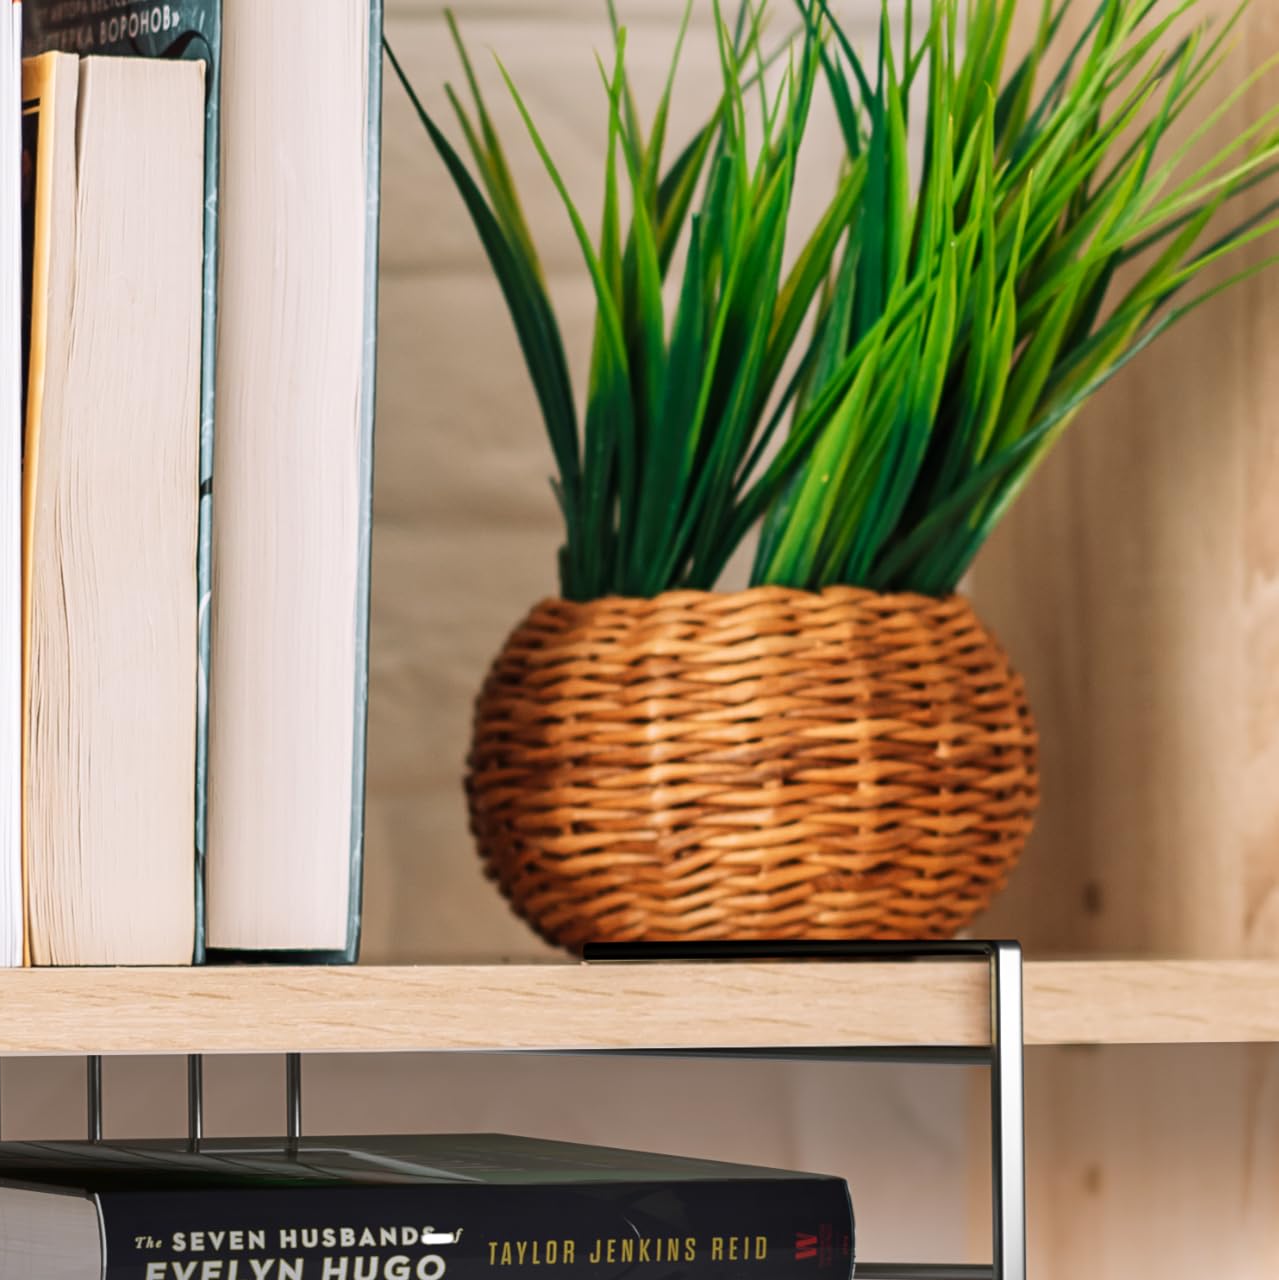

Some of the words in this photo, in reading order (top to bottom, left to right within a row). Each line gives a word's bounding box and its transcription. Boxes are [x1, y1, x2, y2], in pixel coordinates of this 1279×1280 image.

[99, 4, 181, 46] ВОРОНОВ»
[135, 1236, 162, 1249] The
[172, 1230, 266, 1251] SEVEN
[488, 1240, 575, 1265] TAYLOR
[590, 1238, 696, 1264] JENKINS
[712, 1236, 767, 1261] REID
